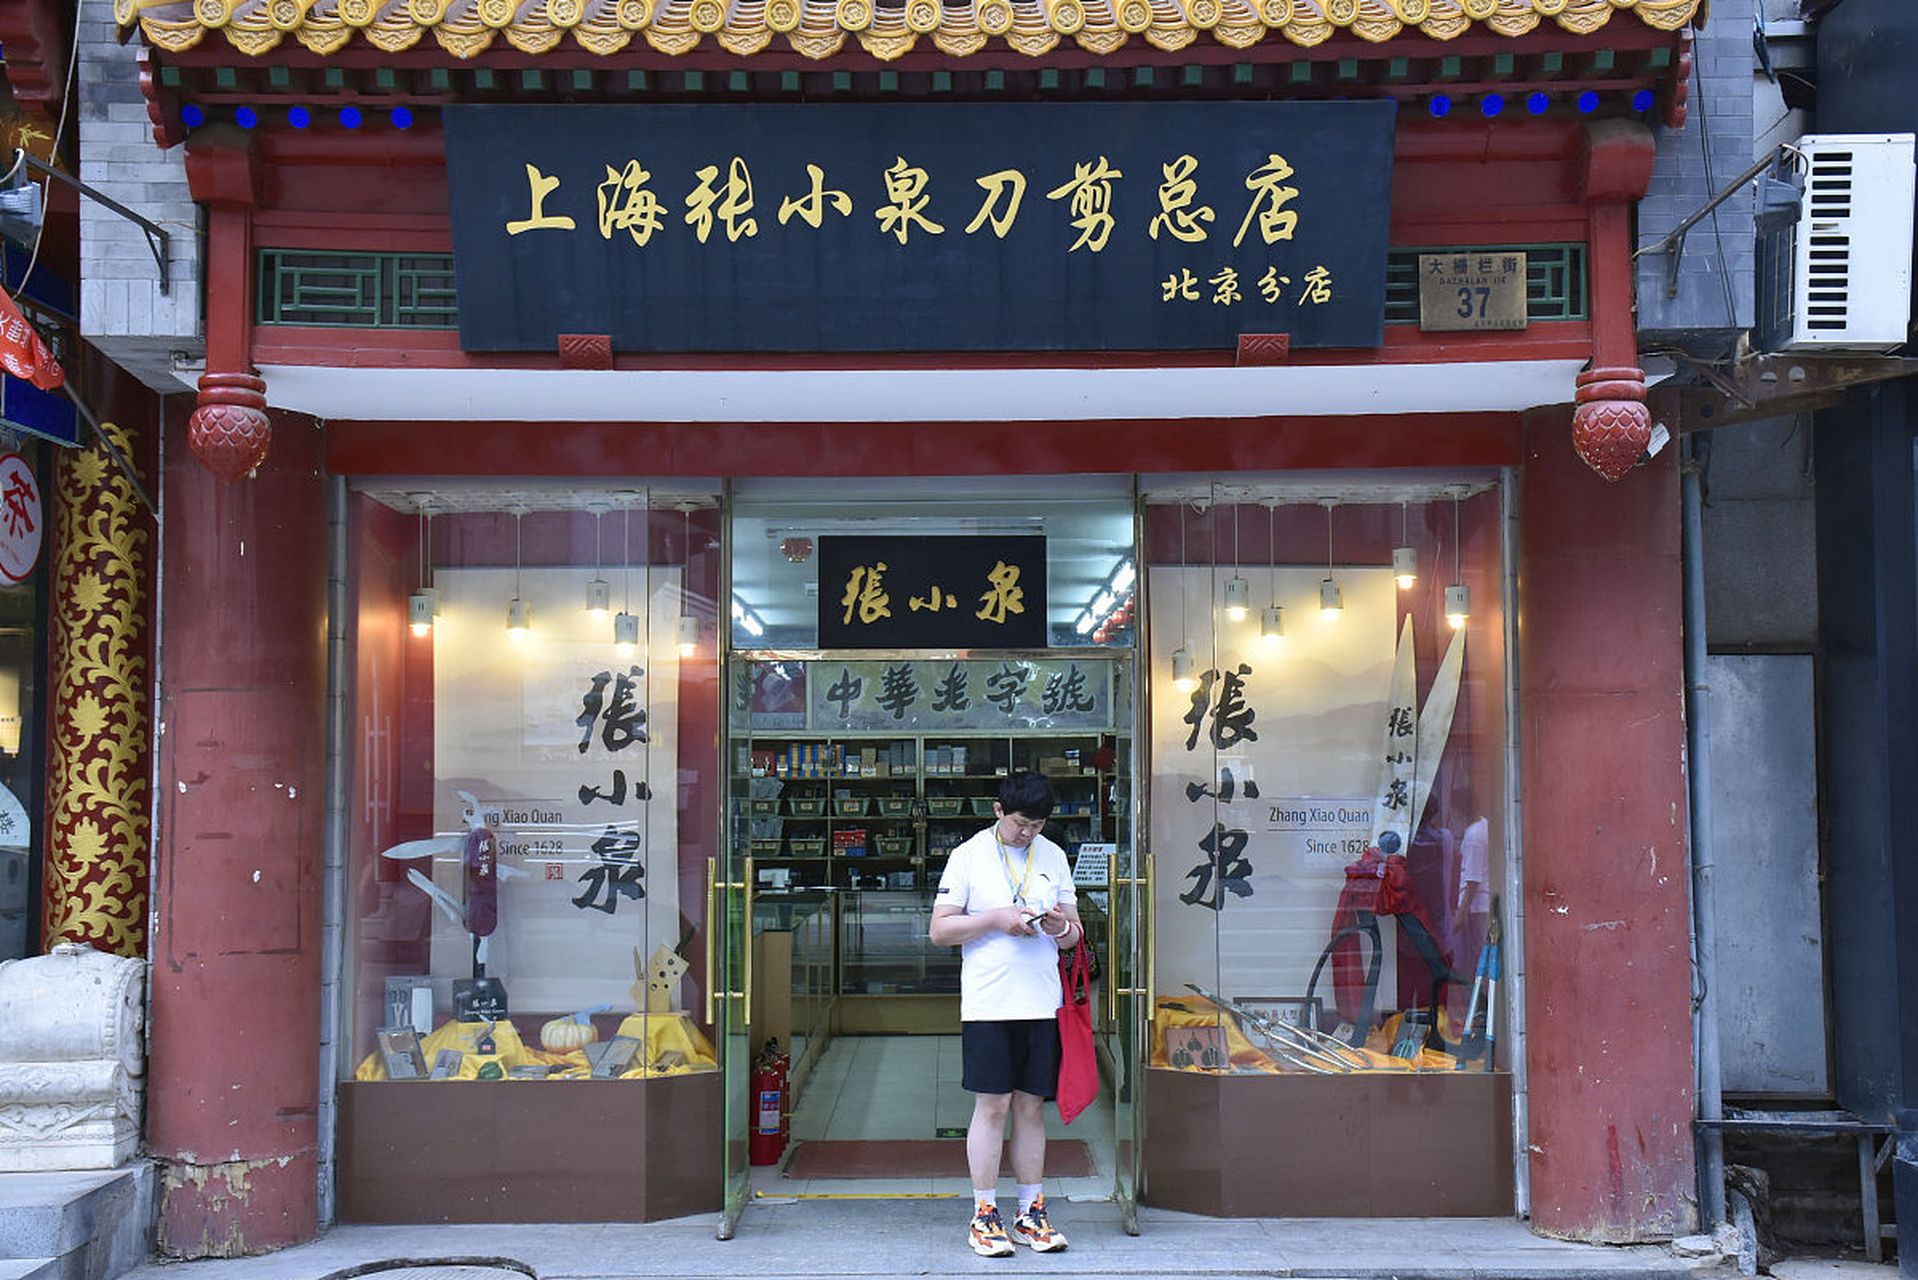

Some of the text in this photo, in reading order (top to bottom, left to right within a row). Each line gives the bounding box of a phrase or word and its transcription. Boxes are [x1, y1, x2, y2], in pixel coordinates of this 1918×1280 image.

[505, 153, 1300, 253] 上海张小泉刀剪总店
[1161, 266, 1333, 307] 北京分店
[1457, 287, 1490, 319] 37
[502, 808, 528, 824] Xiao
[531, 808, 562, 824] Quan
[1269, 806, 1369, 826] Zhang Xiao Quan
[498, 840, 563, 856] Since 1628
[1306, 838, 1370, 854] Since 1628
